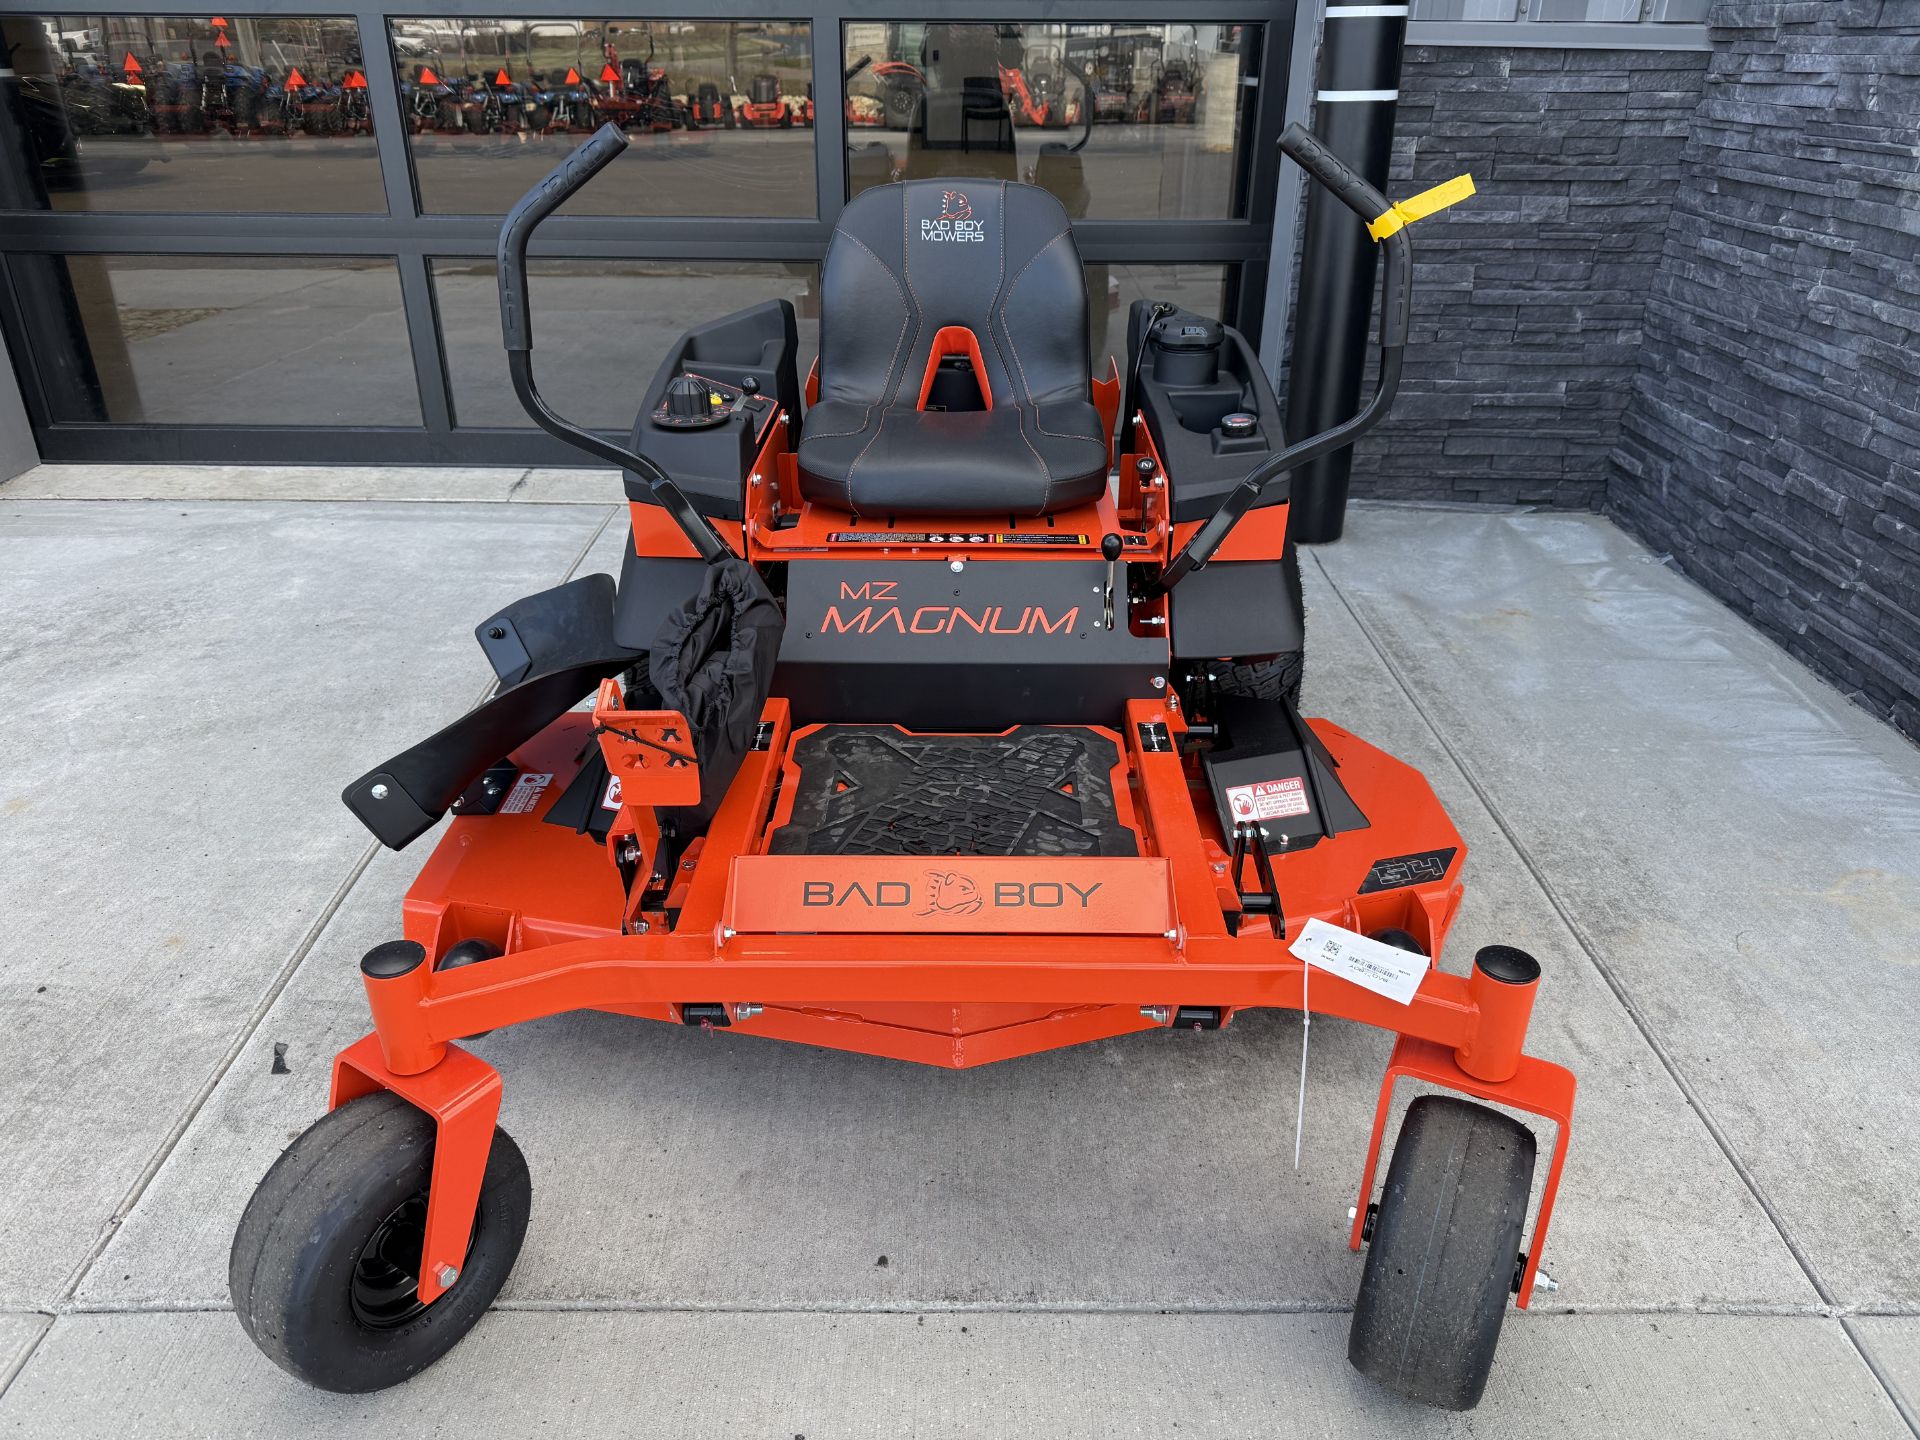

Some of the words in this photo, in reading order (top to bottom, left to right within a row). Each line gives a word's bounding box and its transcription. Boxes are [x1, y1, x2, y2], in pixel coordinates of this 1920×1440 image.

[921, 219, 950, 230] BAD
[955, 220, 984, 231] BOY
[921, 230, 985, 242] MOWERS
[840, 580, 898, 600] MZ
[820, 606, 1079, 634] MAGNUM
[1266, 781, 1300, 793] DANGER
[802, 881, 911, 907] BAD
[994, 882, 1103, 908] BOY
